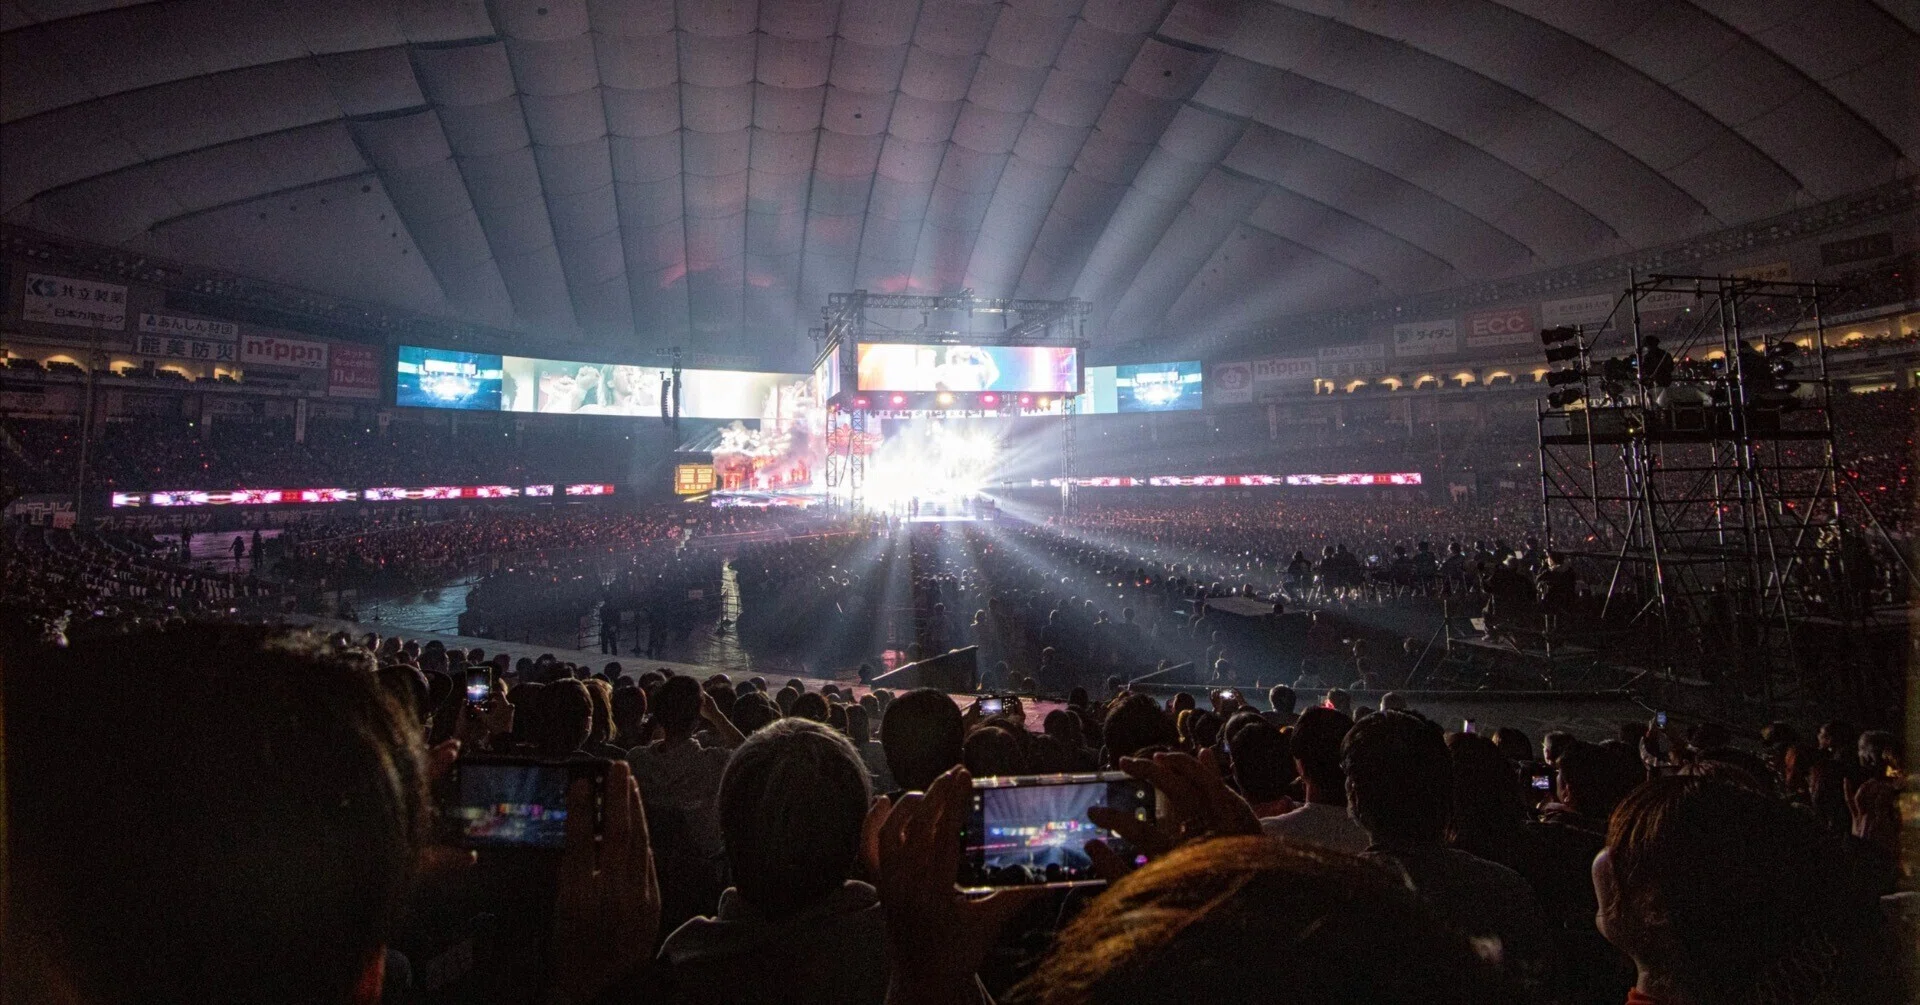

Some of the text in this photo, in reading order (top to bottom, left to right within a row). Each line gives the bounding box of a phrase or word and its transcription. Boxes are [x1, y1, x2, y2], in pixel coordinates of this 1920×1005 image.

[158, 316, 233, 335] あんしん財団
[1473, 315, 1524, 335] ECC
[141, 335, 233, 361] 能美防災
[247, 338, 322, 361] nippn
[1257, 359, 1312, 377] nippn
